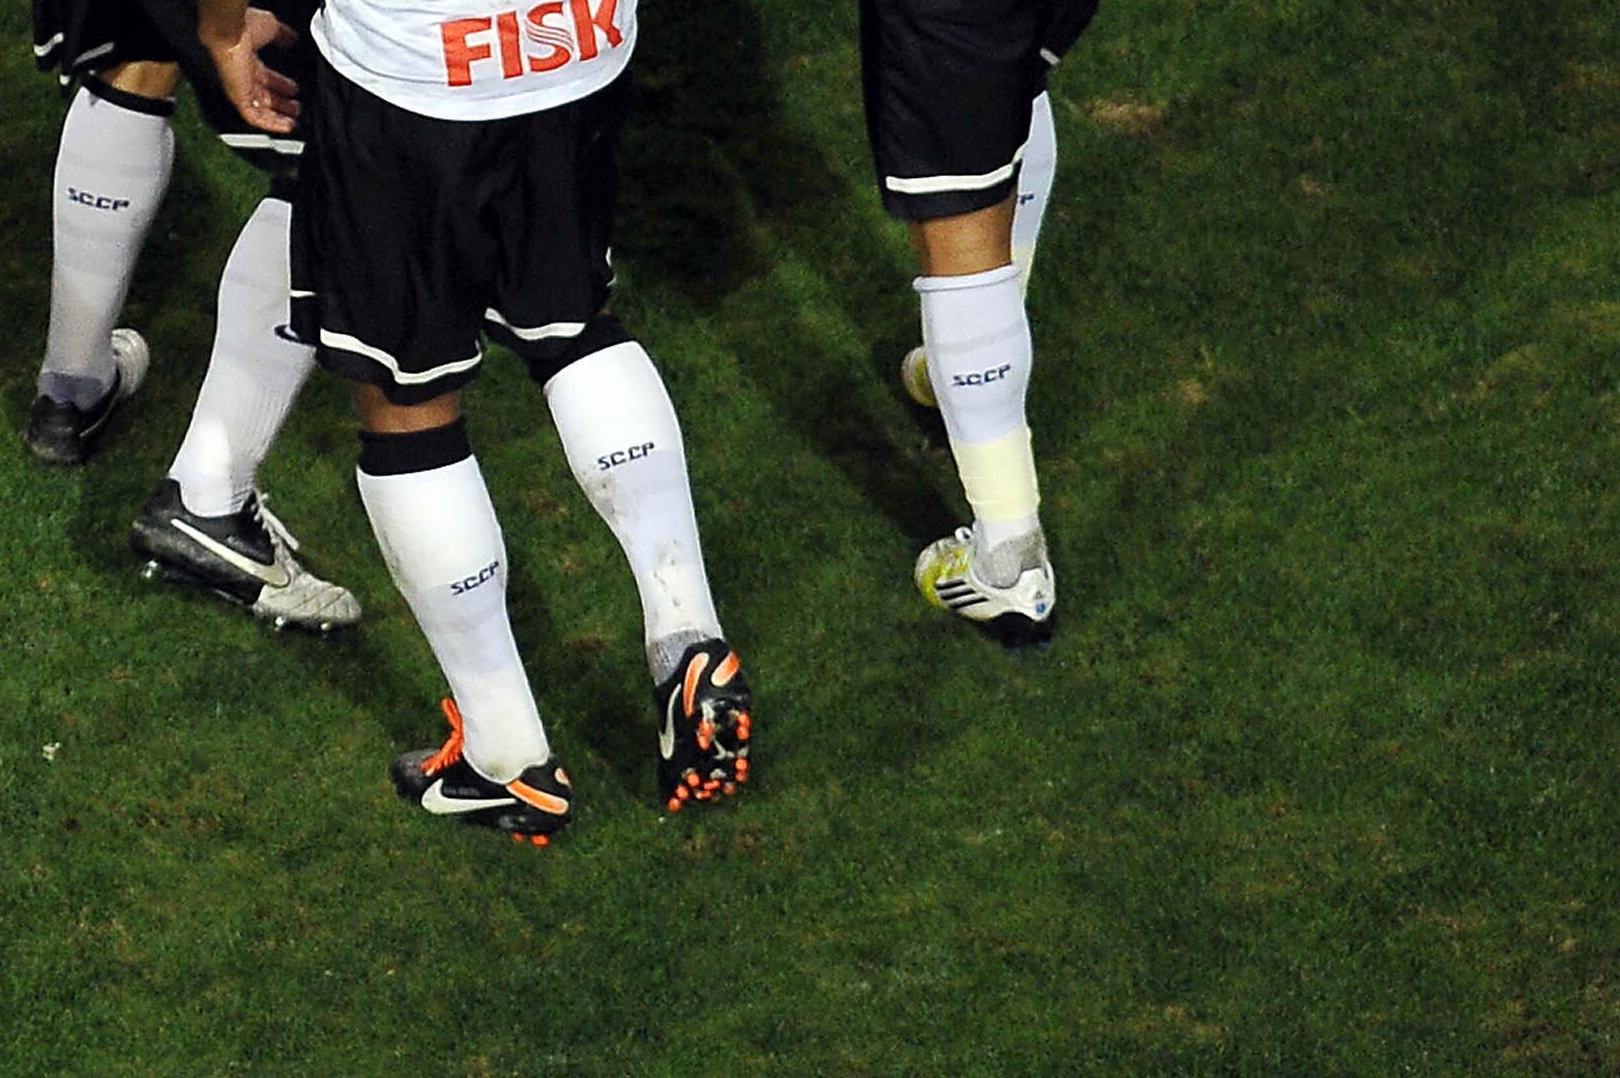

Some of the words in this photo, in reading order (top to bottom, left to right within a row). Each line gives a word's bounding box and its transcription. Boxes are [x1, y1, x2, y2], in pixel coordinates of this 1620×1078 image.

[68, 186, 130, 211] SCCP
[952, 364, 1011, 386] SCCP
[597, 441, 655, 471] SCCP
[450, 560, 500, 596] SCCP
